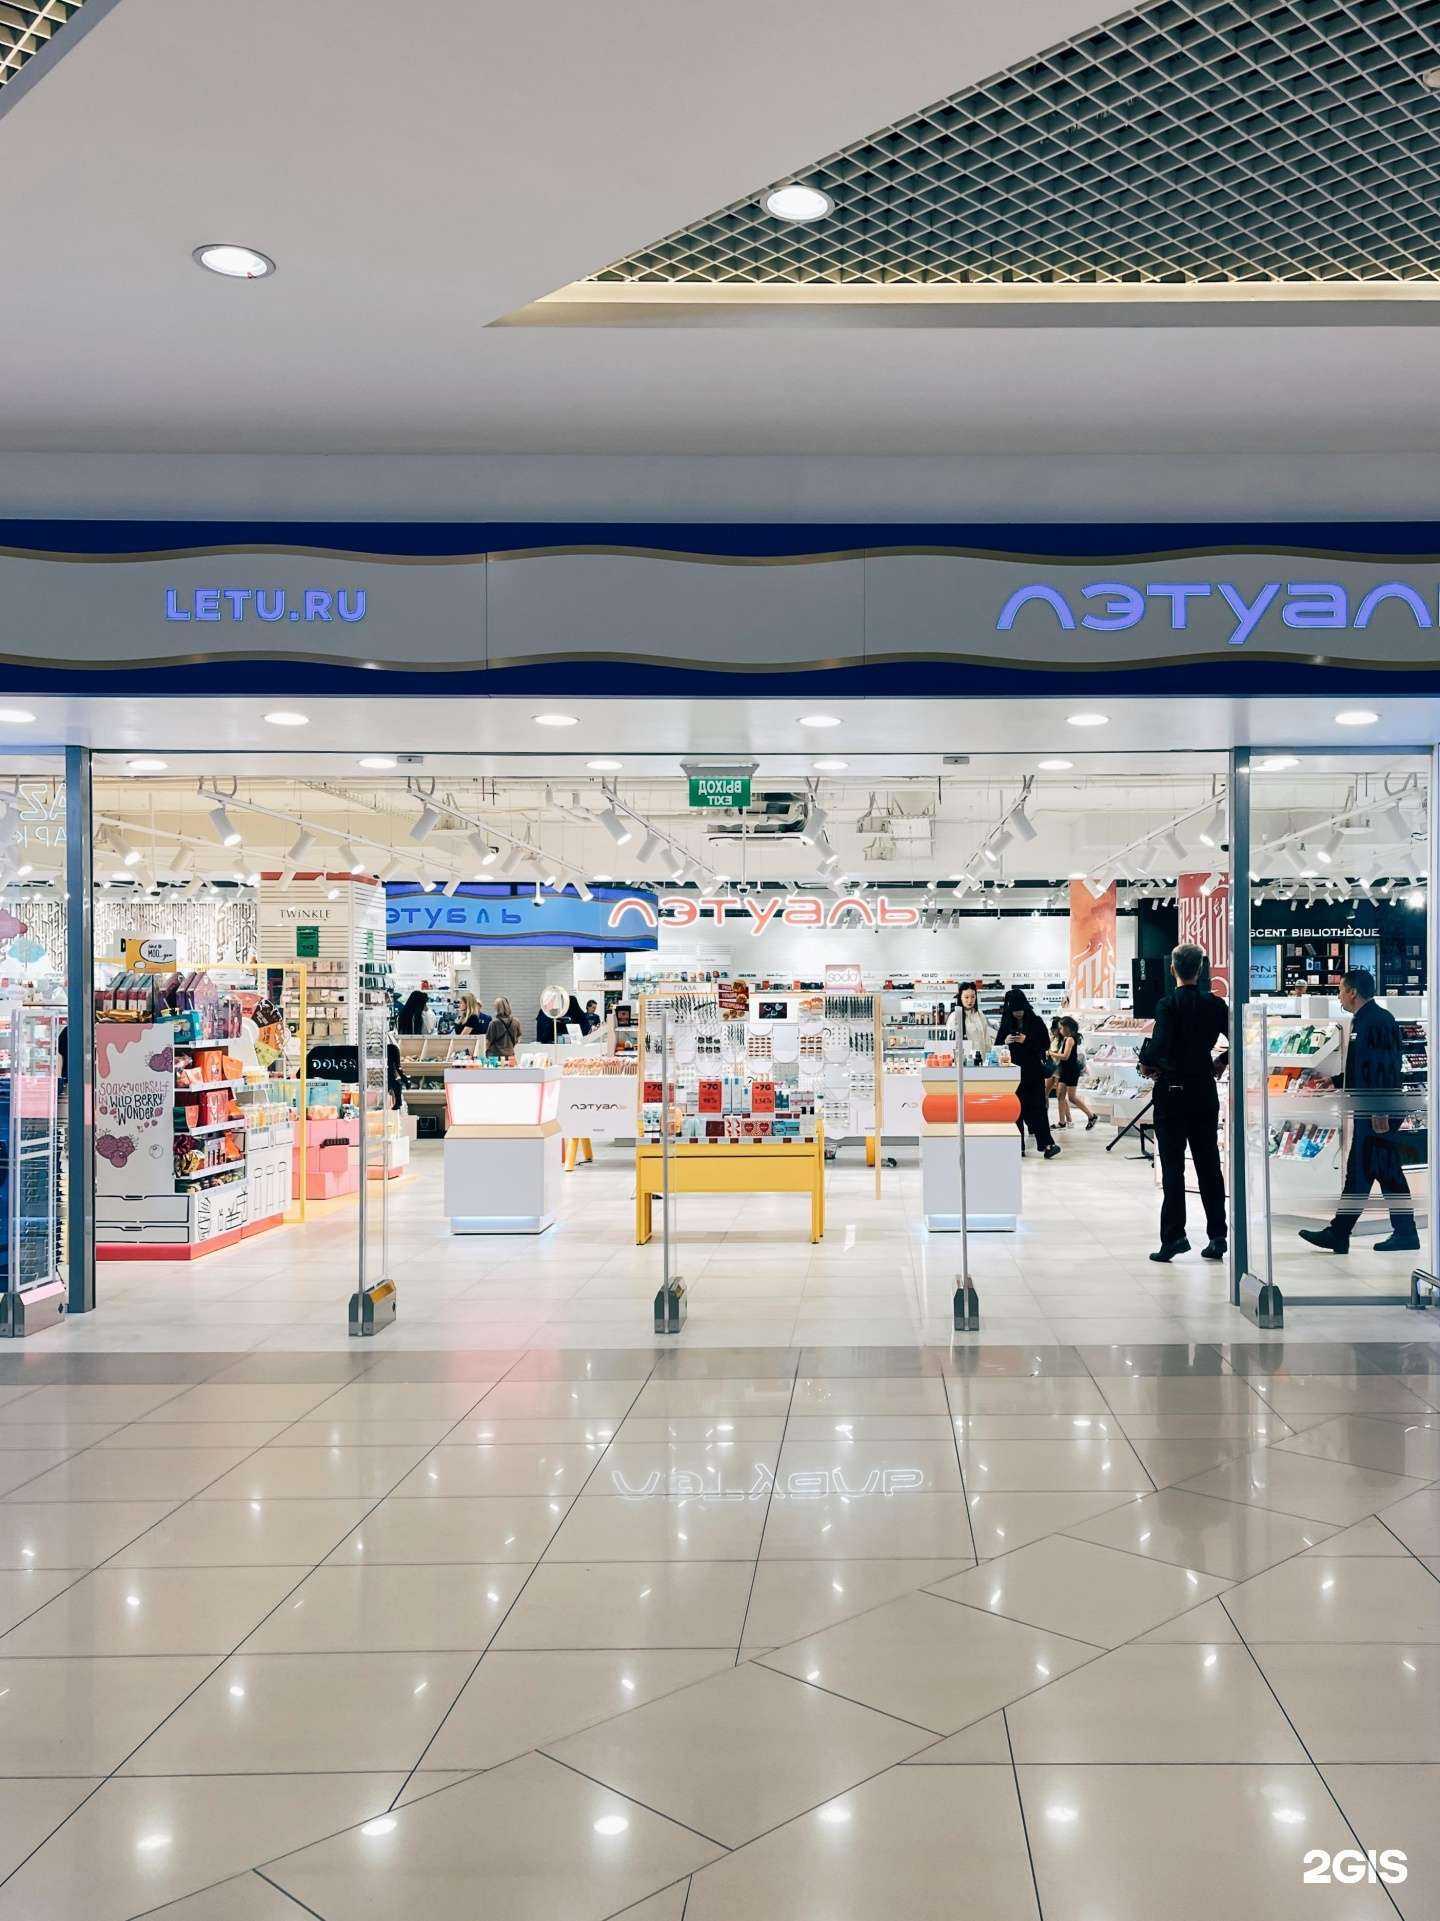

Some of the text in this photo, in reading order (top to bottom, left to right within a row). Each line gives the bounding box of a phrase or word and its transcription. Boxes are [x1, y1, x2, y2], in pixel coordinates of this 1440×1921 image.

[165, 588, 367, 622] LETU.RU
[996, 582, 1440, 645] лэтуал
[280, 908, 331, 919] TWINKLE
[1249, 925, 1380, 938] SCENT BIBLIOTHÈQUE
